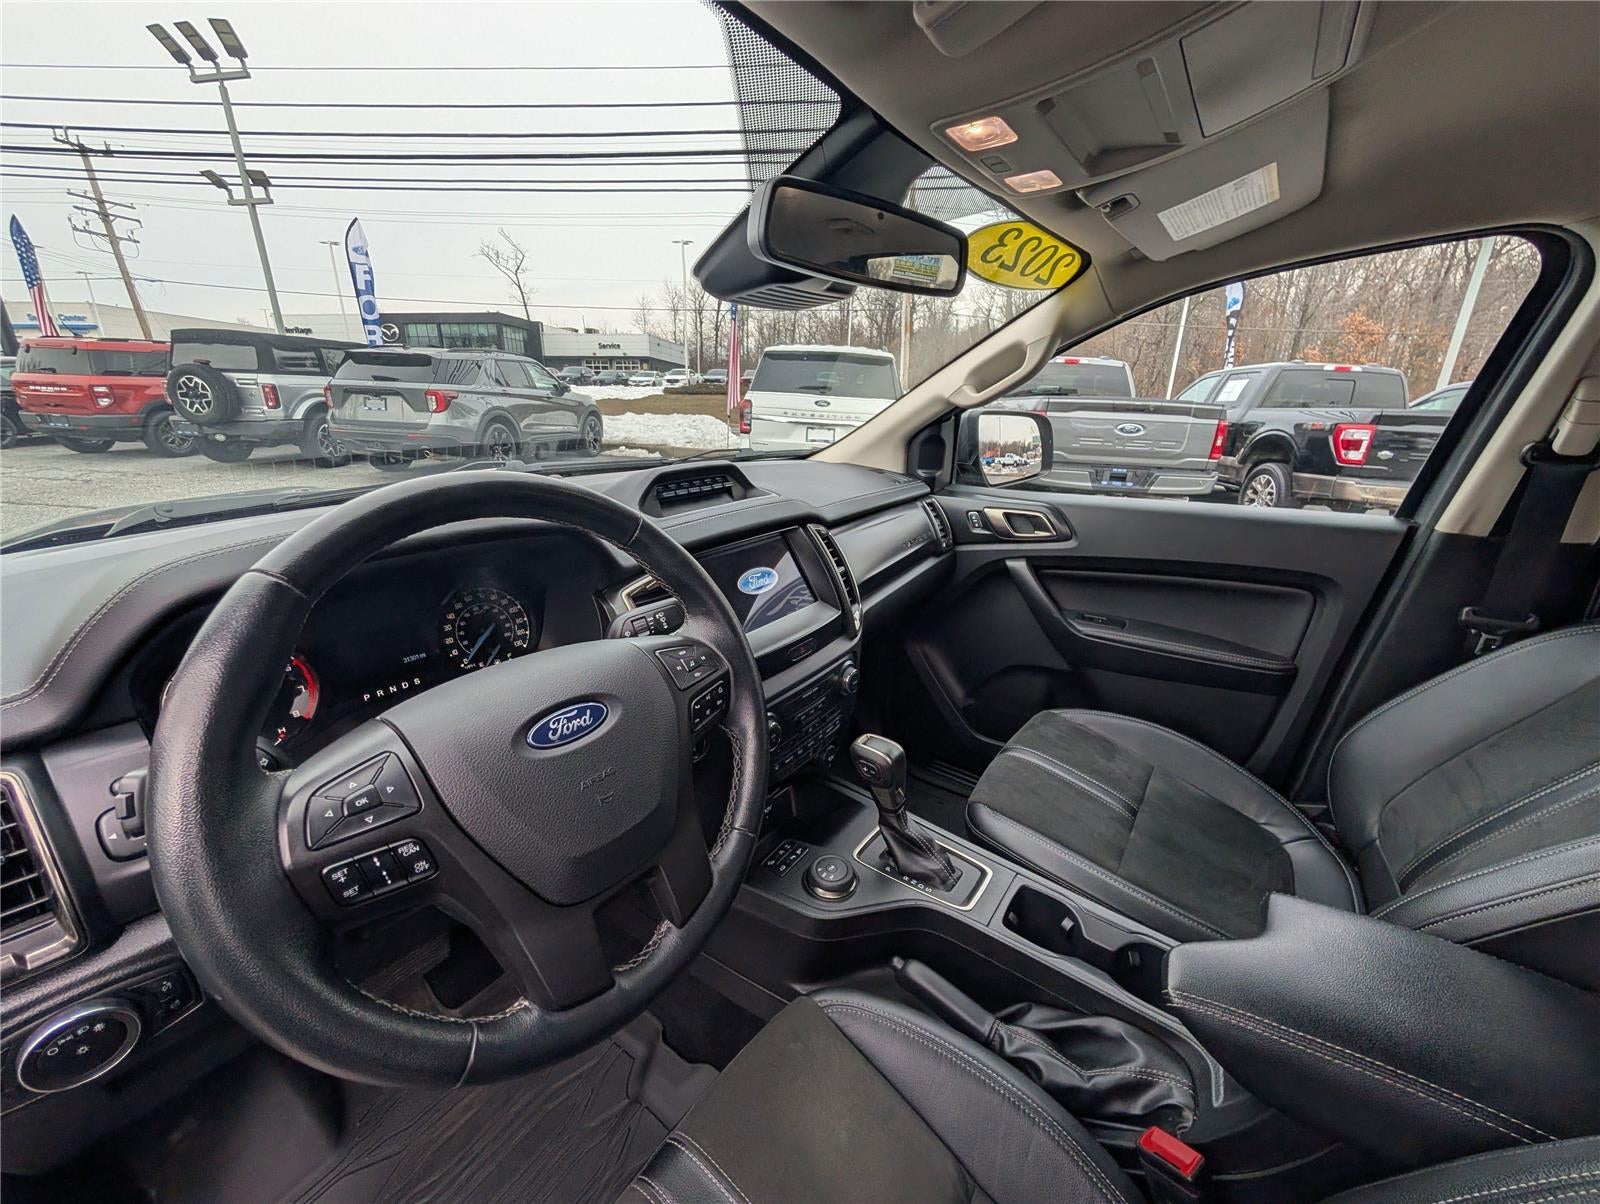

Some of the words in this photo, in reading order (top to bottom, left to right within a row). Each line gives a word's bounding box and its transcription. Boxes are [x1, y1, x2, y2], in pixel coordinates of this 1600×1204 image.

[598, 342, 621, 350] Service
[748, 572, 770, 590] Ford
[363, 693, 370, 701] P
[376, 689, 384, 698] R
[389, 685, 397, 693] N
[401, 681, 409, 689] D
[413, 677, 421, 685] S
[548, 708, 594, 741] Ford
[355, 797, 369, 807] OK
[398, 842, 415, 854] RES
[403, 845, 420, 857] CAN
[413, 860, 426, 869] ON
[415, 863, 430, 873] OFF
[331, 867, 349, 881] SET
[342, 885, 359, 898] SET
